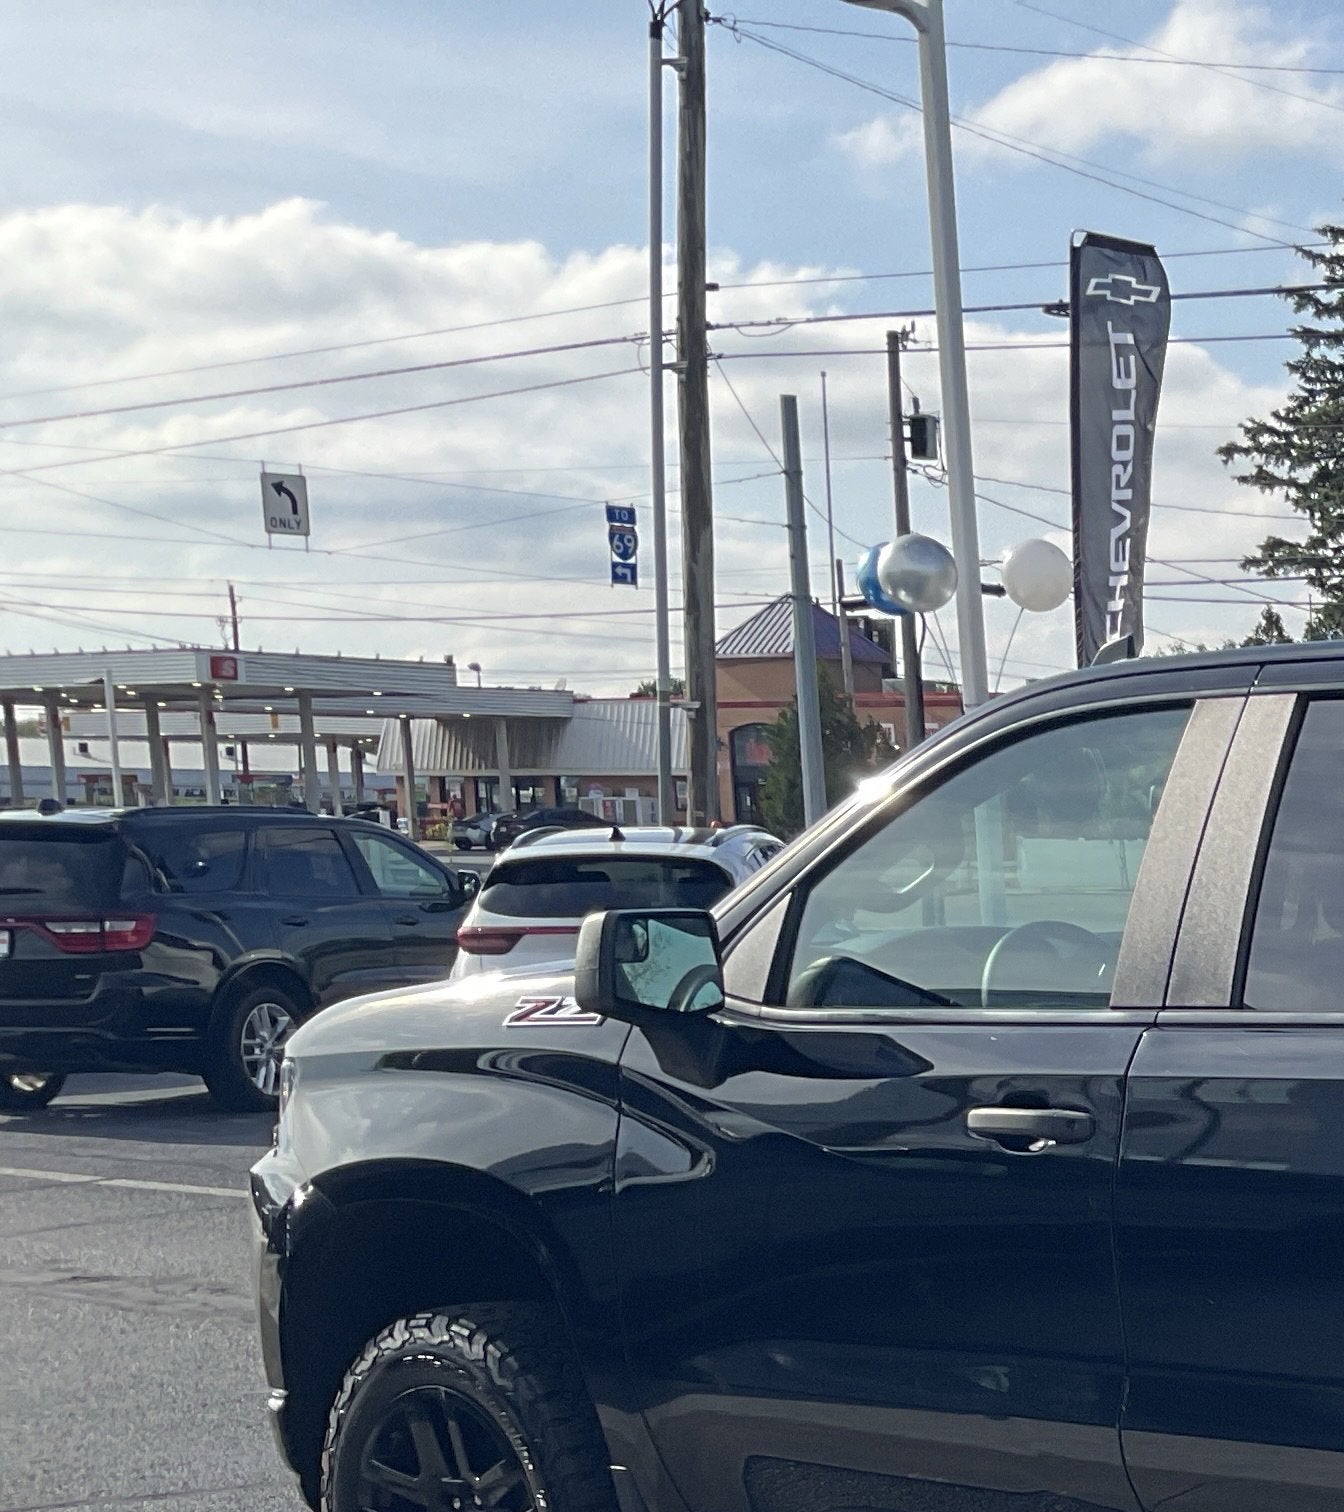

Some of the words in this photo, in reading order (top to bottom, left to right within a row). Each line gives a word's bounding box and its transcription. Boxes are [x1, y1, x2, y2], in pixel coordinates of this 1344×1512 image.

[1106, 320, 1137, 643] CHEVROLET
[270, 516, 301, 530] ONLY
[614, 509, 629, 521] TO
[613, 534, 634, 555] 69
